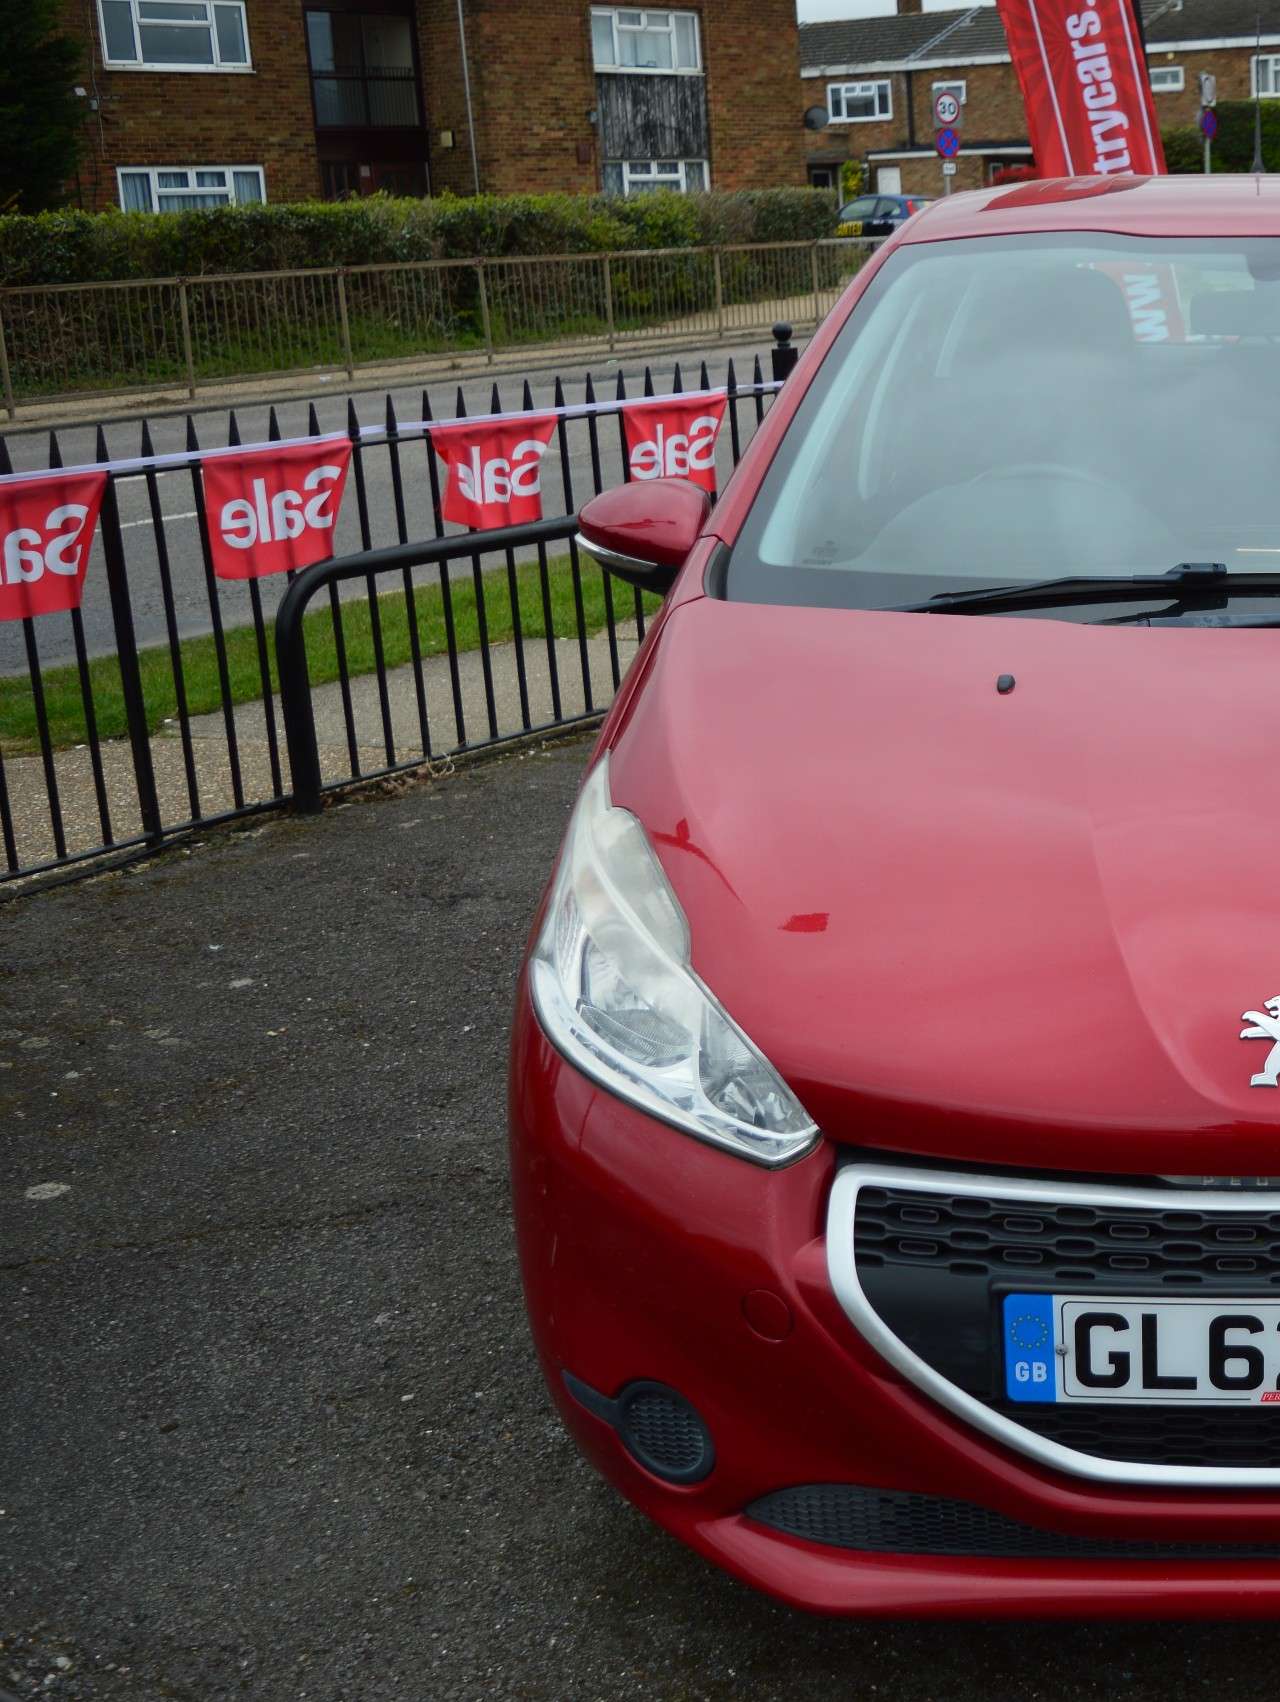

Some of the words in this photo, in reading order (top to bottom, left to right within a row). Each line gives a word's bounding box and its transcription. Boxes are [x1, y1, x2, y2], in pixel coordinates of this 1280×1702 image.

[1066, 0, 1134, 175] trycars.
[940, 102, 955, 115] 30
[1015, 1362, 1047, 1382] GB
